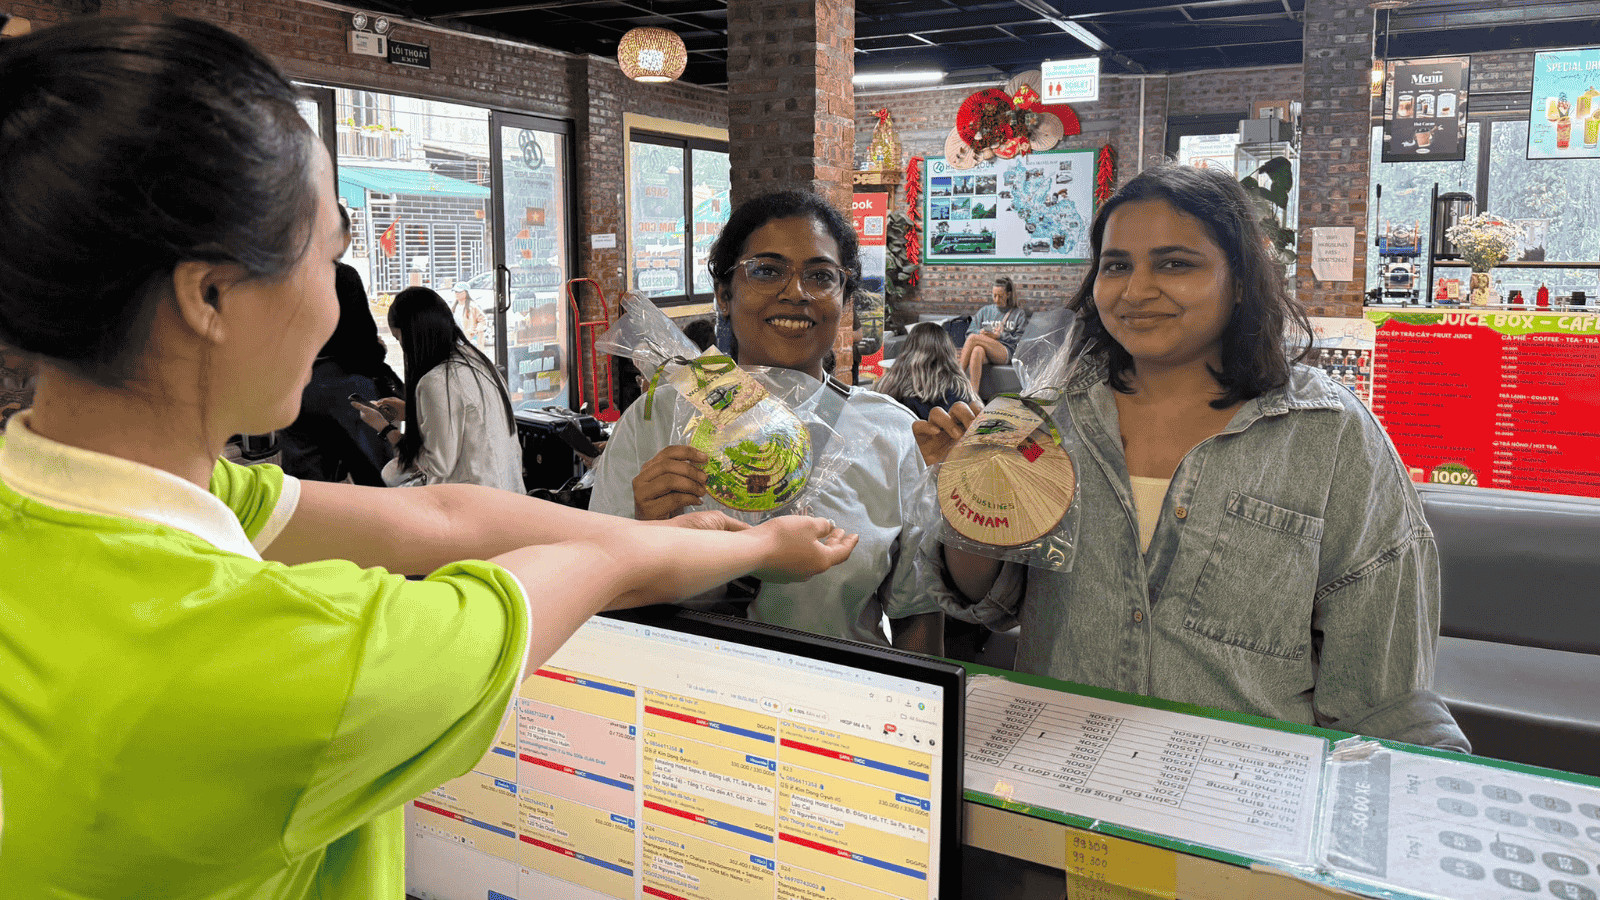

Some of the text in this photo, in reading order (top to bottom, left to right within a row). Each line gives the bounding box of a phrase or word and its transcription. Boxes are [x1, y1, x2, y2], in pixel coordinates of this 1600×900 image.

[1546, 62, 1583, 72] SPECIAL
[1411, 73, 1443, 84] Menu
[852, 199, 873, 210] ook
[1437, 313, 1488, 326] JUICE
[1494, 314, 1534, 329] BOX
[984, 411, 1019, 419] WOMEN'S
[1432, 470, 1478, 486] 100%
[950, 487, 1009, 528] VIETNAM
[1005, 709, 1033, 719] 1050k
[1002, 723, 1023, 731] 700k
[1086, 719, 1116, 729] 1200k
[996, 729, 1020, 738] 650k
[1082, 726, 1111, 735] 1100k
[1079, 740, 1104, 748] 750k
[1171, 736, 1202, 746] 1650k
[1075, 746, 1099, 755] 700k
[1163, 749, 1196, 760] 1150k
[970, 754, 1000, 765] Cabin
[1070, 753, 1097, 762] 600k
[1161, 756, 1194, 767] 1050k
[1066, 760, 1092, 769] 600k
[1164, 765, 1191, 774] 950k
[1061, 767, 1087, 776] 500k
[1054, 773, 1084, 784] Cabin
[1152, 787, 1180, 797] 720k
[1355, 781, 1371, 795] XE
[791, 794, 813, 806] Amazing
[814, 800, 829, 809] Hotel
[1146, 794, 1178, 806] Cabin
